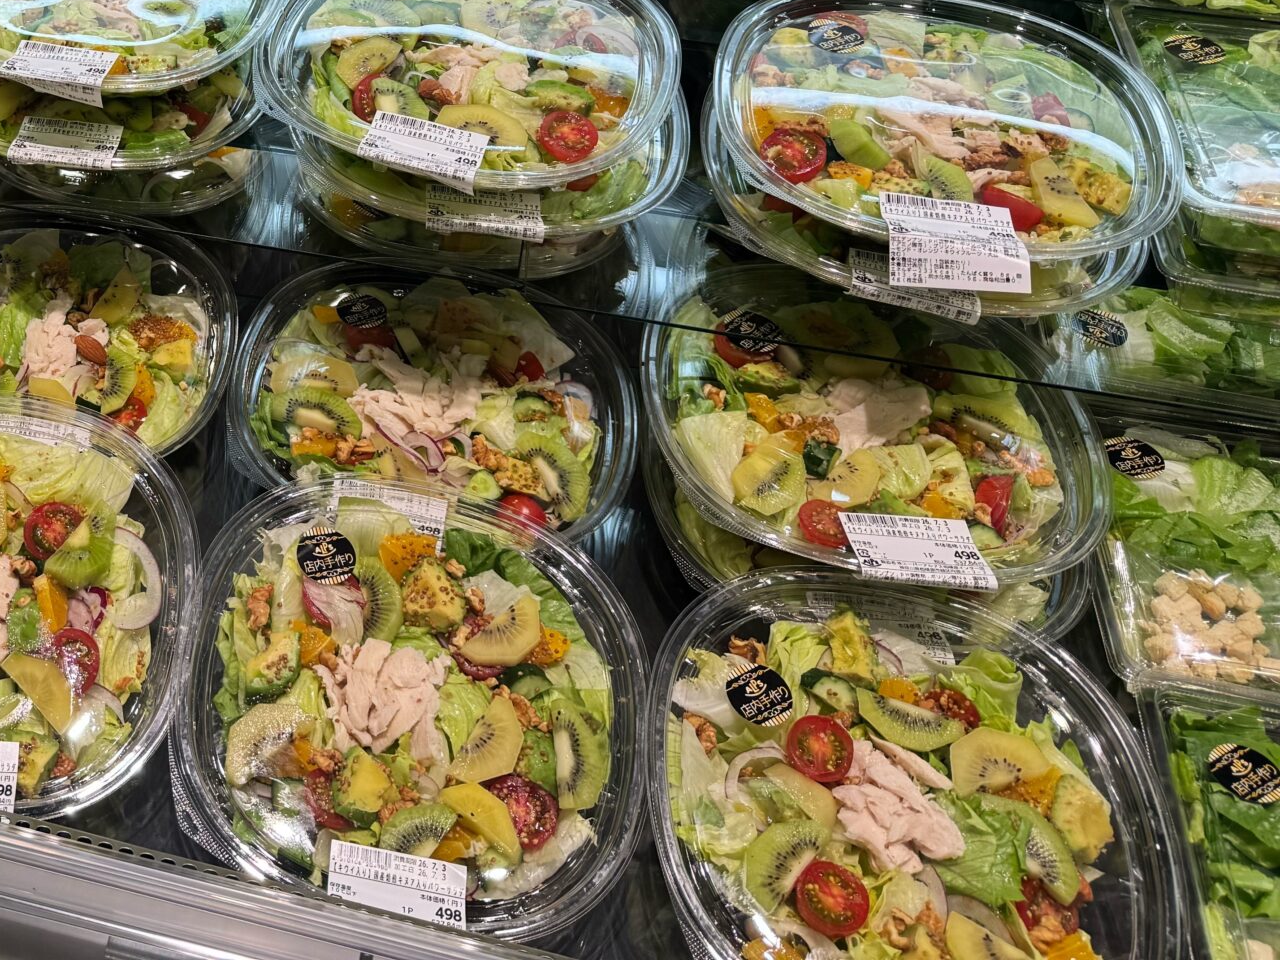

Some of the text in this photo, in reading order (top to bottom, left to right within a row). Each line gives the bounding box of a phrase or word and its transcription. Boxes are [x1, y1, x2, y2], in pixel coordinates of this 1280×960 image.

[819, 32, 862, 49] 店内手作り
[455, 157, 477, 167] 498
[1116, 454, 1164, 471] 店内手作り
[418, 525, 441, 535] 498
[302, 551, 353, 573] 店内手作り
[954, 551, 980, 560] 498
[741, 686, 790, 720] 店内手作り
[1231, 765, 1278, 797] 店内手作り
[435, 907, 462, 921] 498
